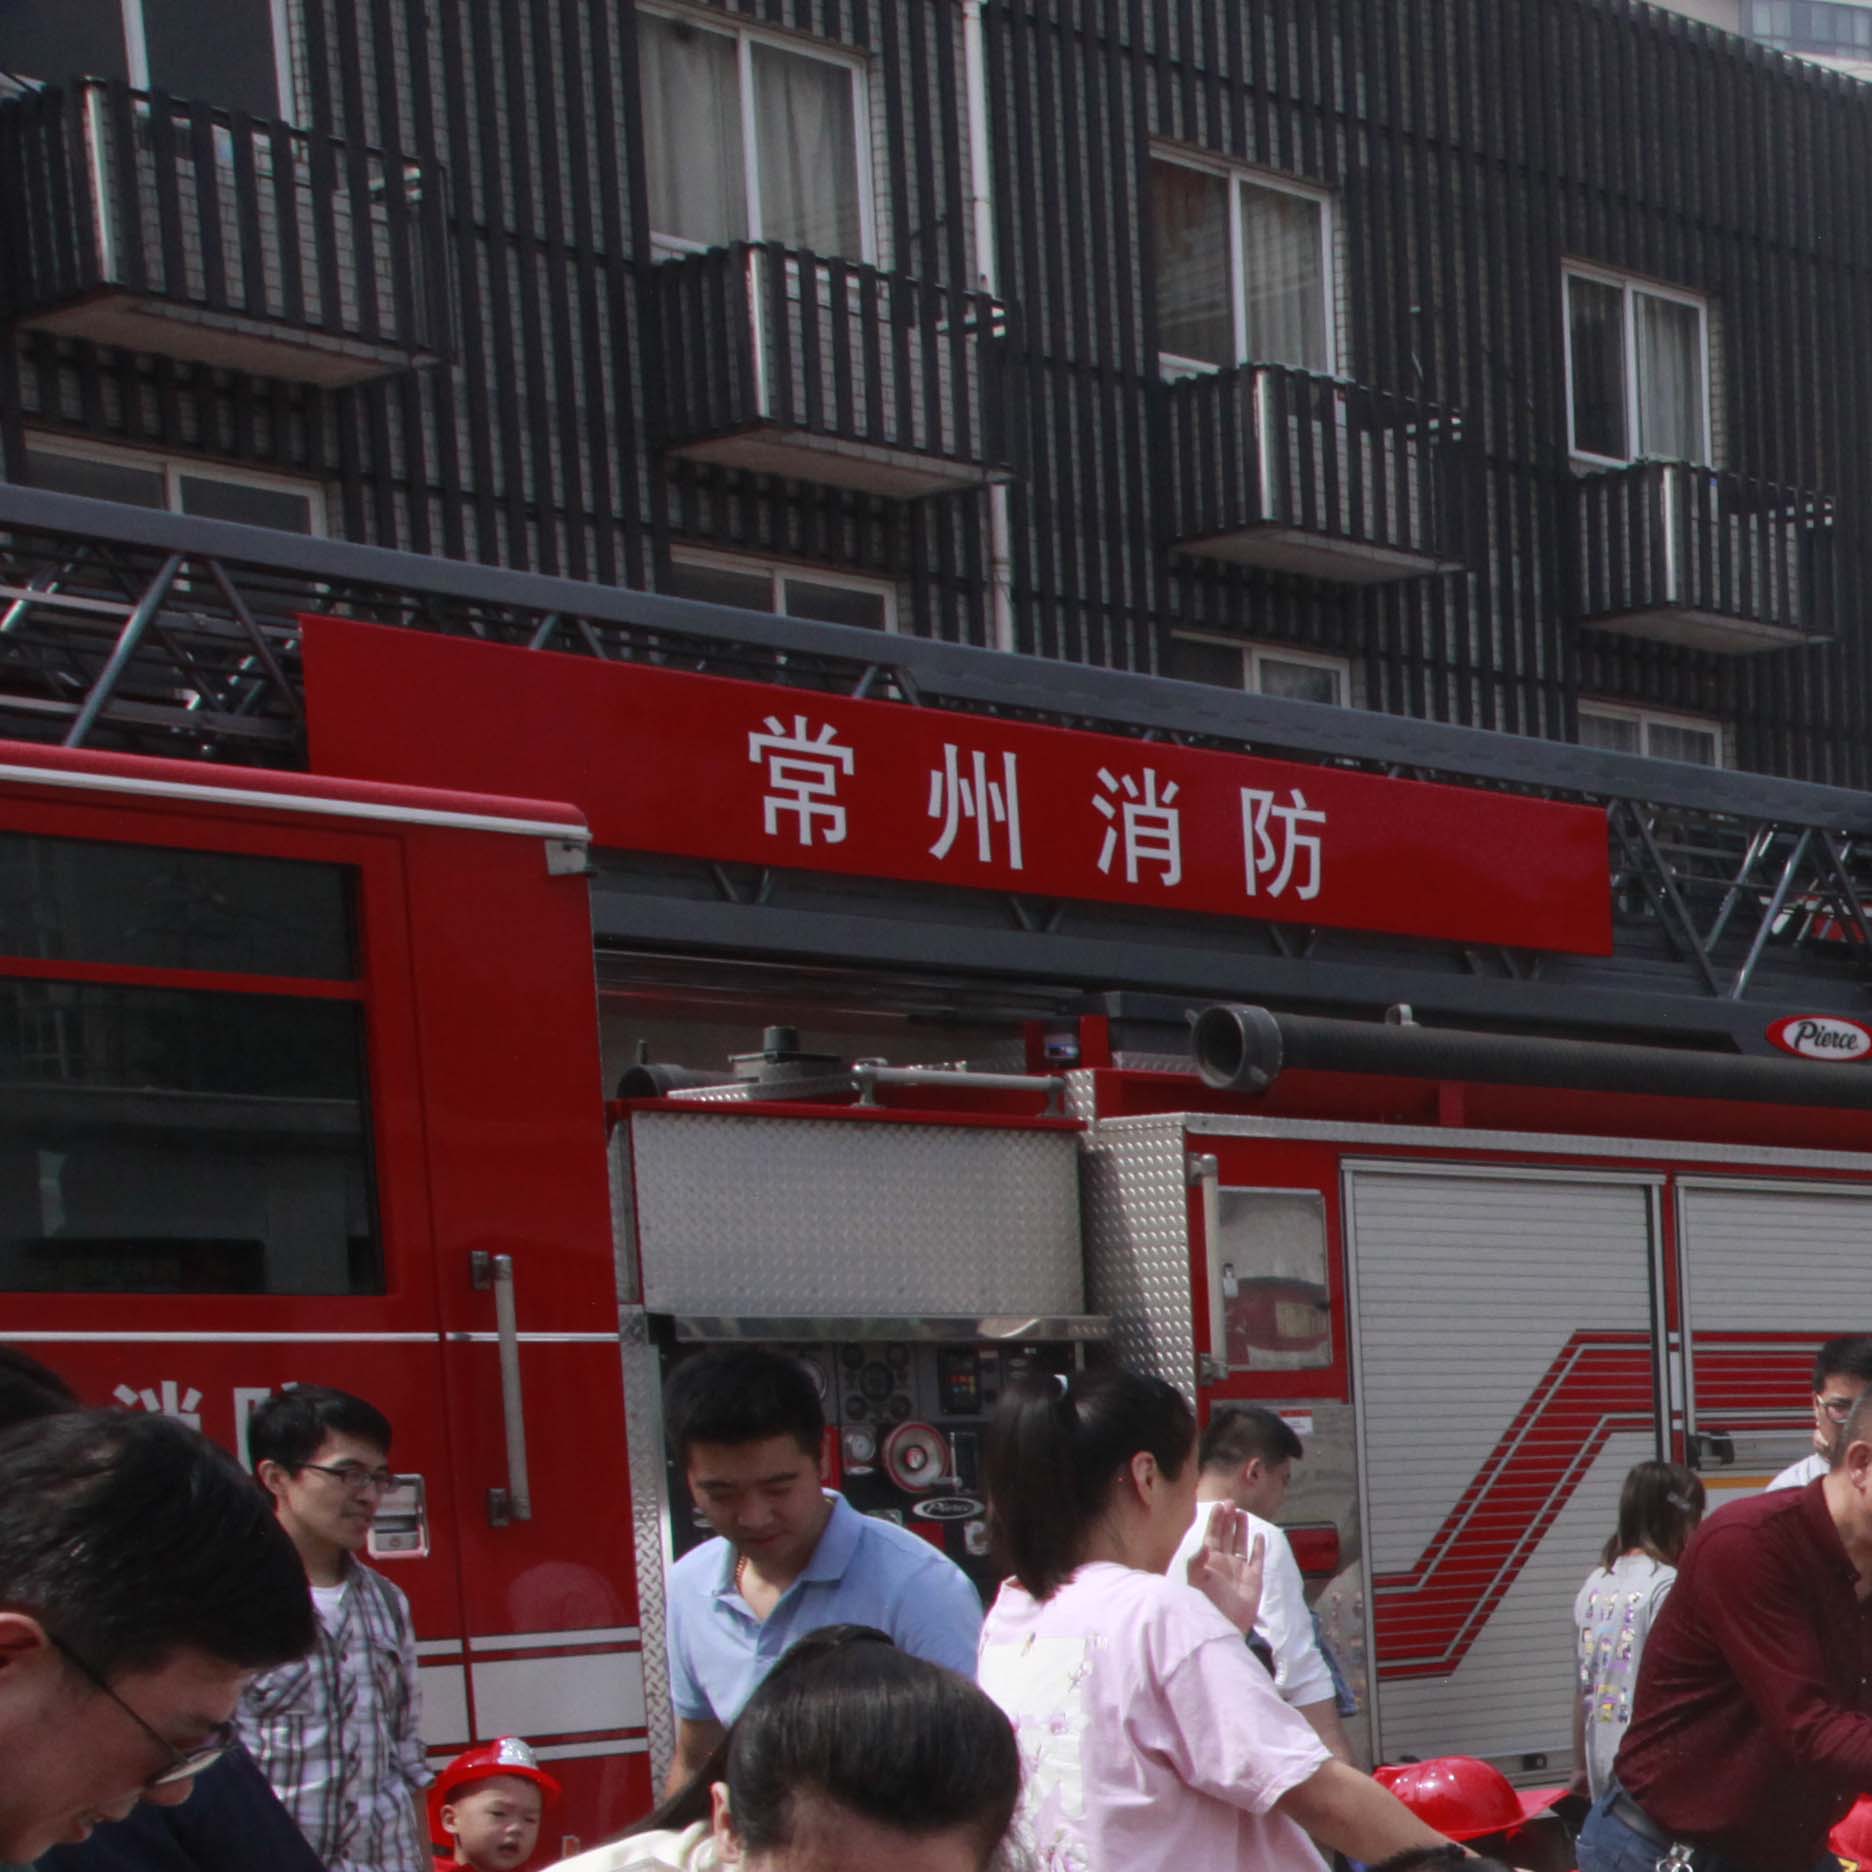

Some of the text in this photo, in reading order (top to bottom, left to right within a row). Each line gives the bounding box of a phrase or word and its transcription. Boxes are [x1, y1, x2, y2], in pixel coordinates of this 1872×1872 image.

[747, 713, 1327, 902] 常州消防
[1794, 1020, 1857, 1050] Pierce
